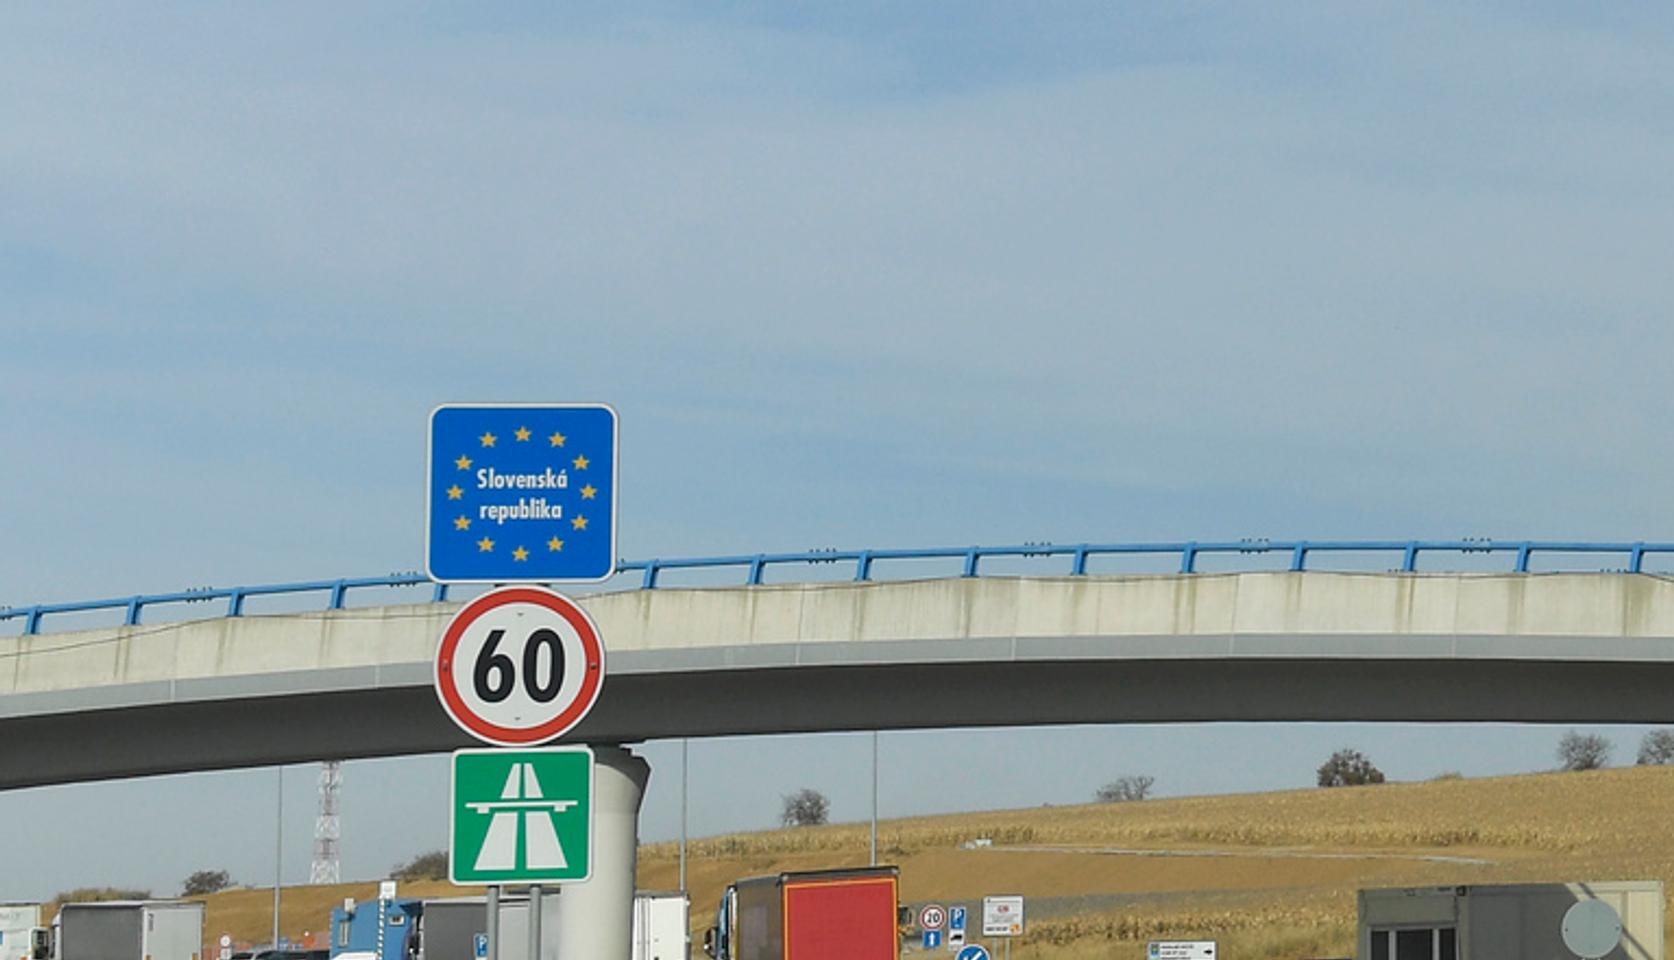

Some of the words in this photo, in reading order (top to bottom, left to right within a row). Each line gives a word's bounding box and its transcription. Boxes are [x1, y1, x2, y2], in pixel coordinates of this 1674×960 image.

[477, 467, 568, 490] Slovenská
[479, 498, 562, 525] republika
[473, 627, 566, 704] 60
